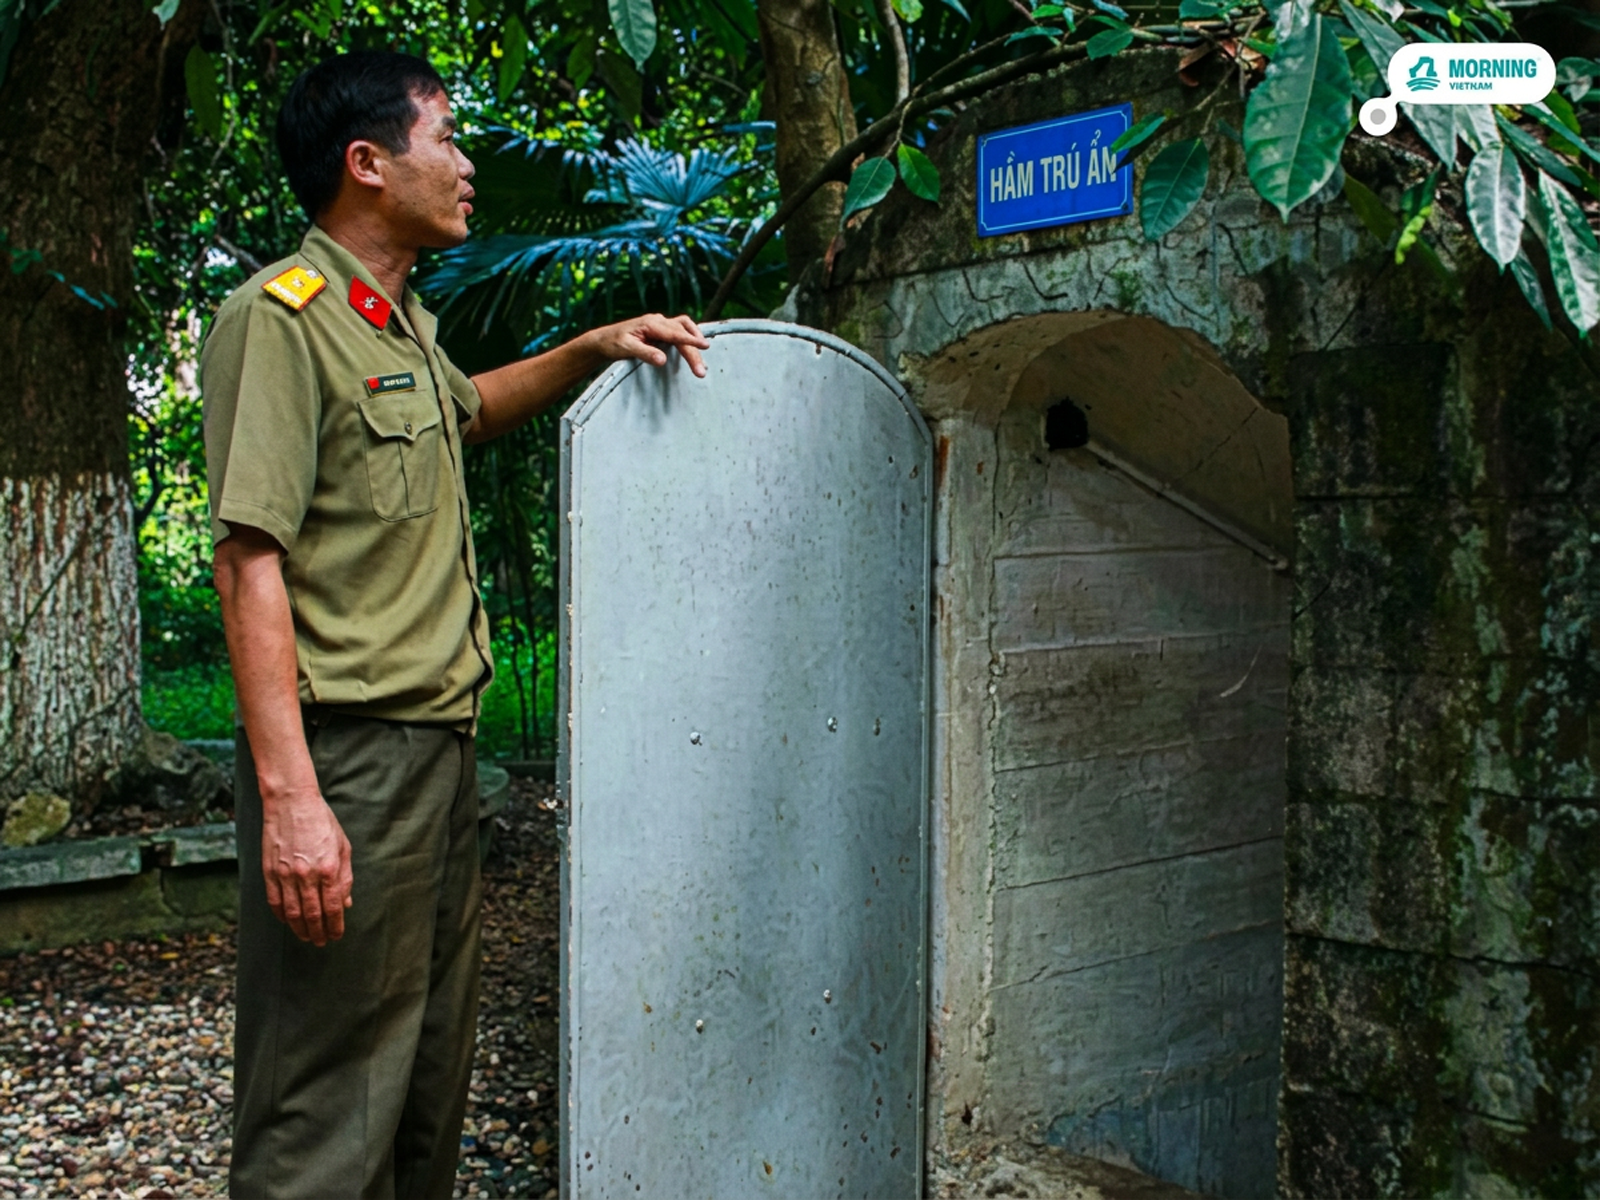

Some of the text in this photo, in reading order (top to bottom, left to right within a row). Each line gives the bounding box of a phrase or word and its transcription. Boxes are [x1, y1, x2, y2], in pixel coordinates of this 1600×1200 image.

[990, 129, 1117, 203] HẦM TRÚ ẨN
